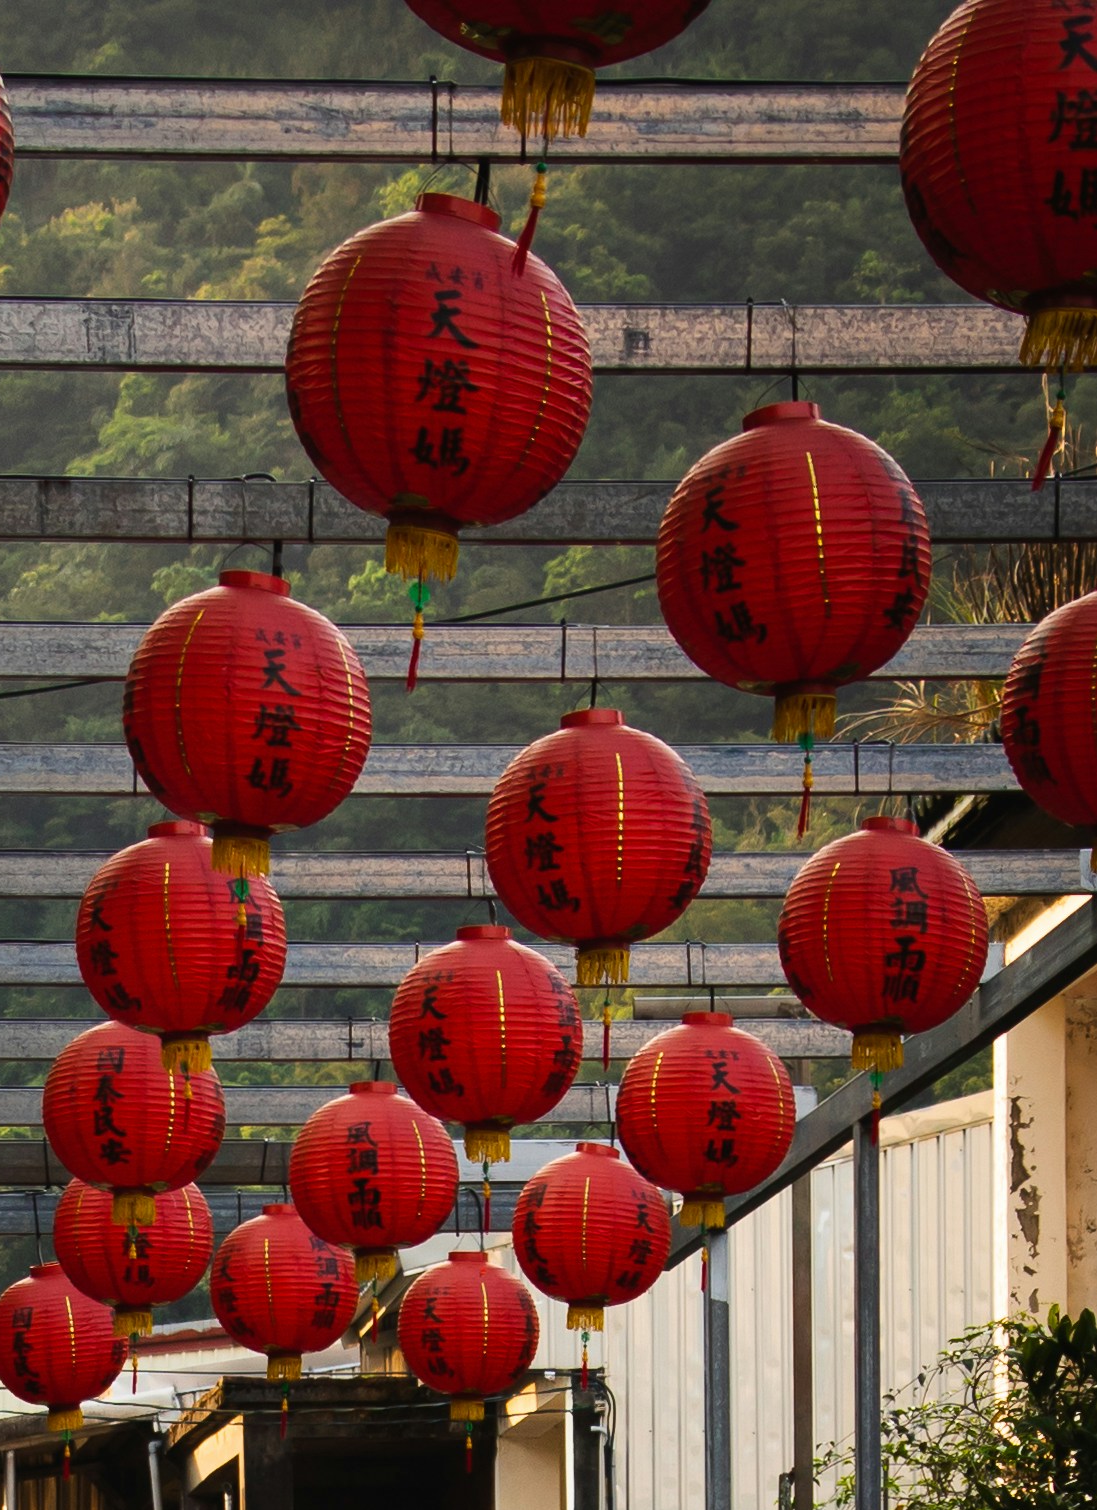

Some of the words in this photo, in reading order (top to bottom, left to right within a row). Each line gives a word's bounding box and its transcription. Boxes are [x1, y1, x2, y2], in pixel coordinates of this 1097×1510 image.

[410, 289, 480, 478] 天燈媽
[700, 484, 769, 644] 天燈媽
[245, 649, 302, 798] 天燈媽
[525, 783, 581, 913] 天燈媽
[880, 866, 928, 1004] 風調雨順
[94, 1047, 132, 1165] 國泰民安
[707, 1062, 742, 1168] 天燈媽
[347, 1121, 385, 1230] 風調雨順
